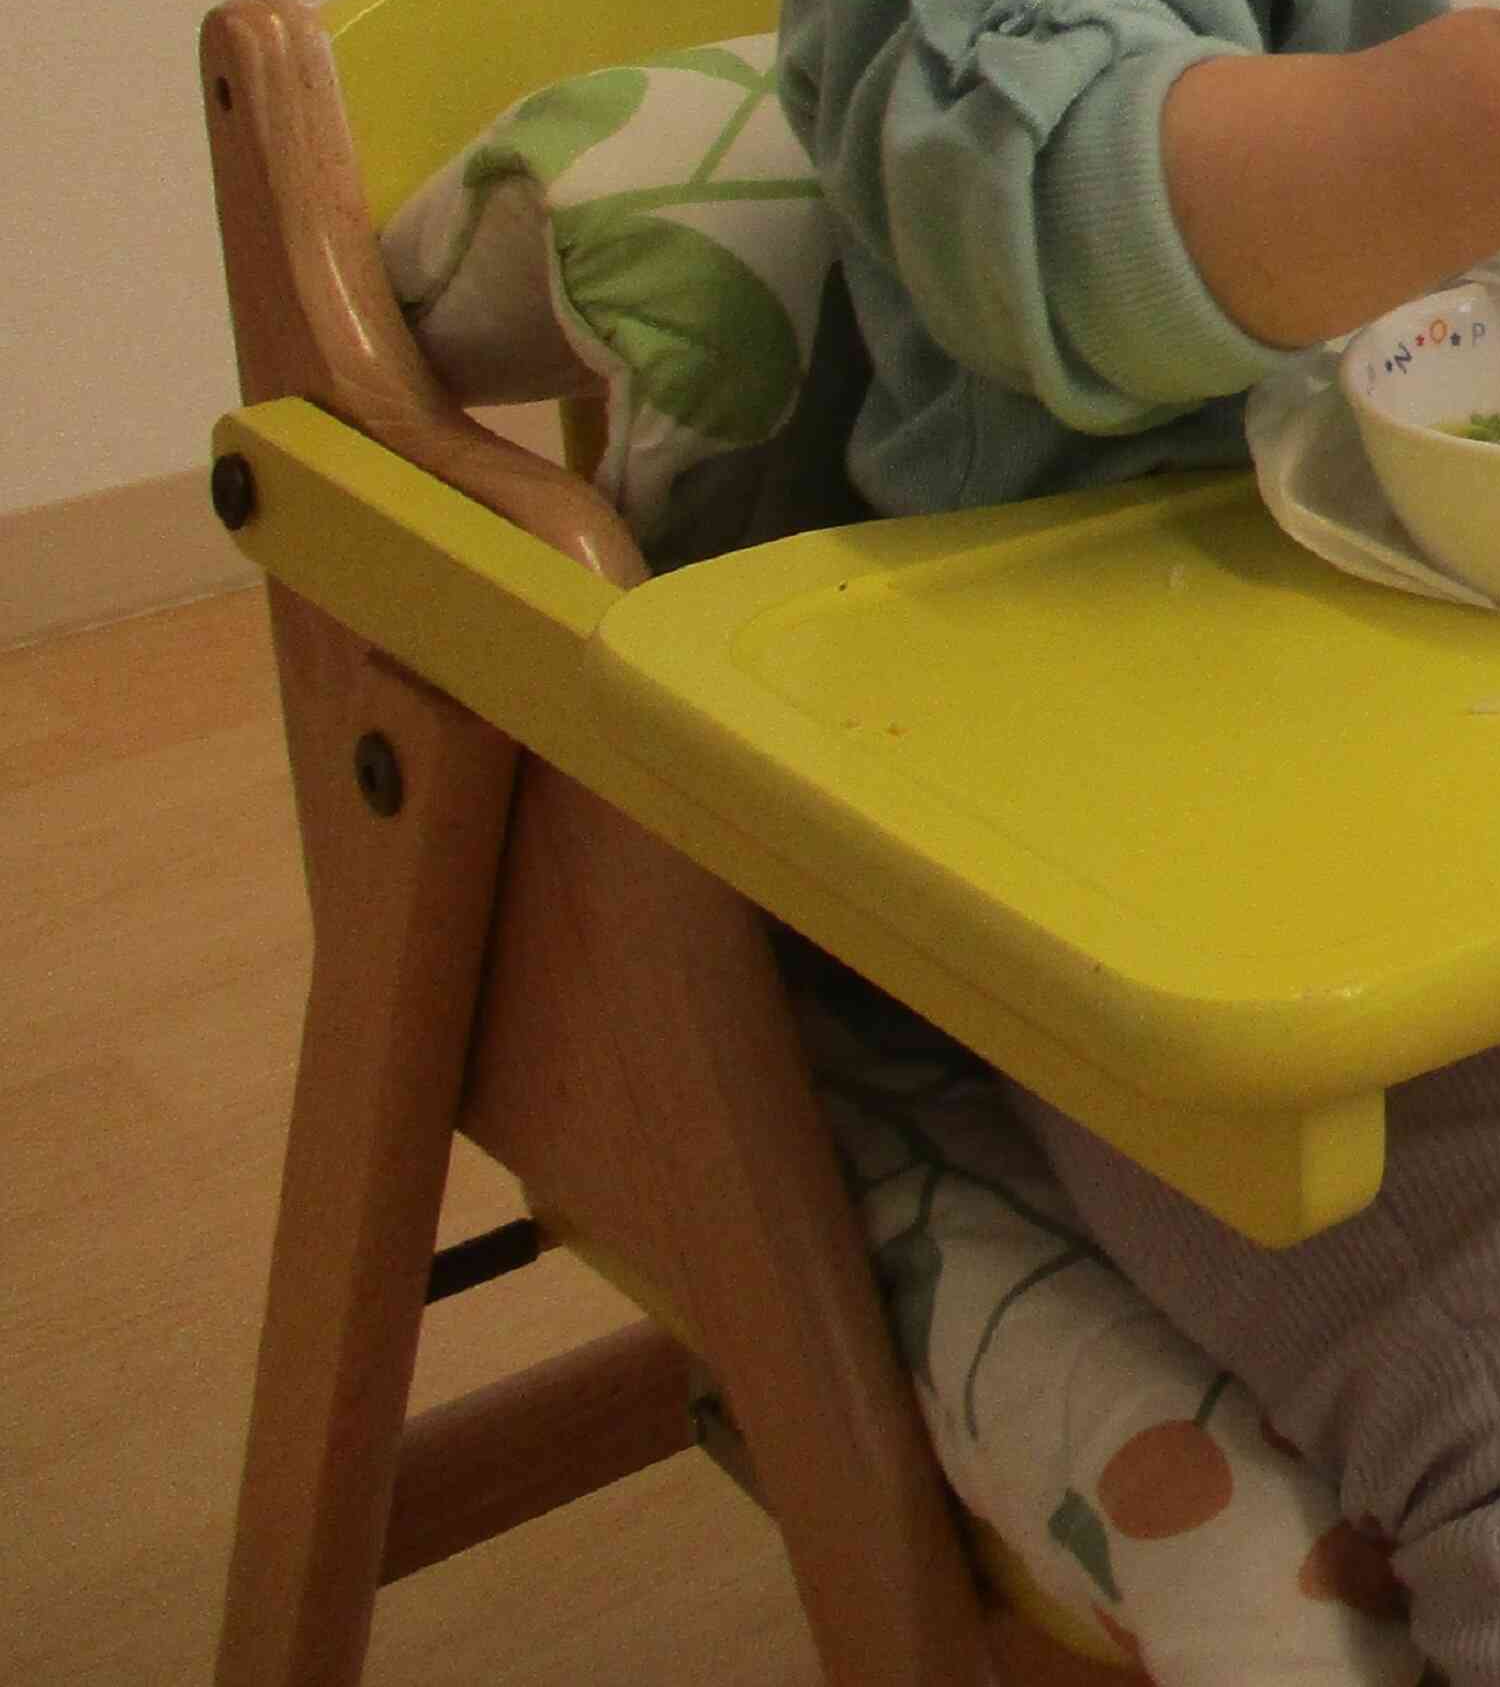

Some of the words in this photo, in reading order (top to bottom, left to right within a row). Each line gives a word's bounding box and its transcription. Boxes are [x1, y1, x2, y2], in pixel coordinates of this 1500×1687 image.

[1394, 342, 1412, 374] N
[1429, 319, 1448, 344] O
[1471, 322, 1487, 347] P
